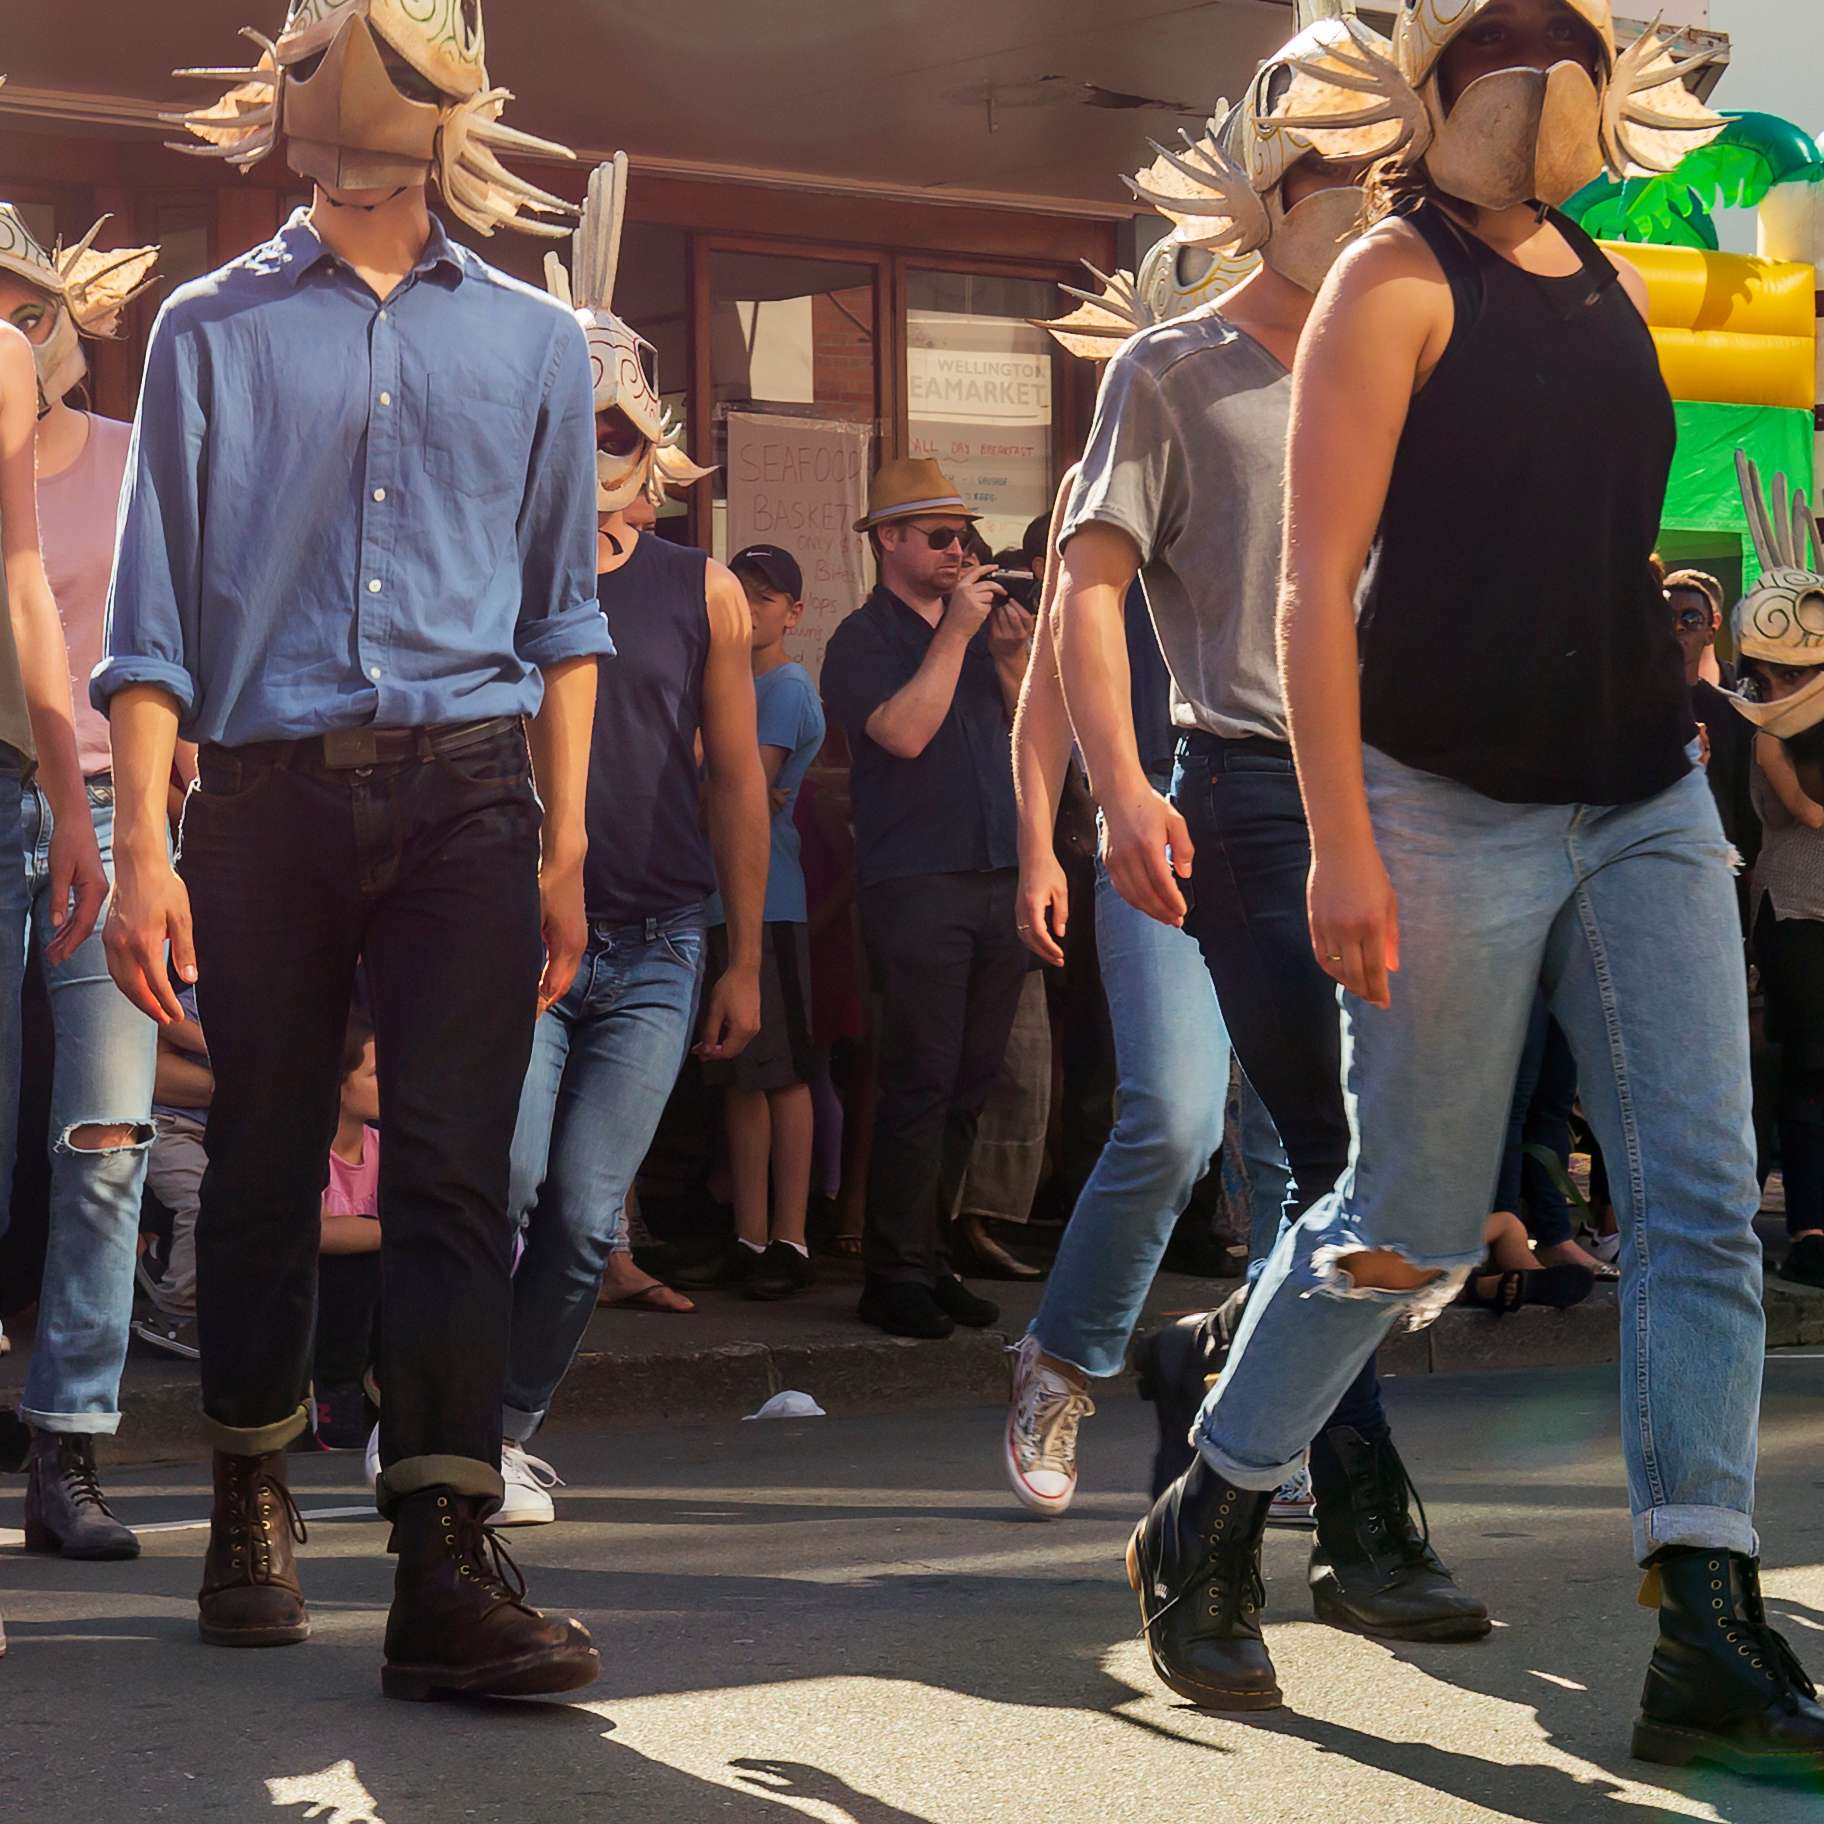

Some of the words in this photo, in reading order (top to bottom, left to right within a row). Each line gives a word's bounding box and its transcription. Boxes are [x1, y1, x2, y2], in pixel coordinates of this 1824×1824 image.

[937, 359, 1048, 380] WELLINGTON
[909, 376, 1049, 406] EAMARKET
[739, 443, 860, 483] SEAFOOD
[752, 494, 854, 532] BASKET
